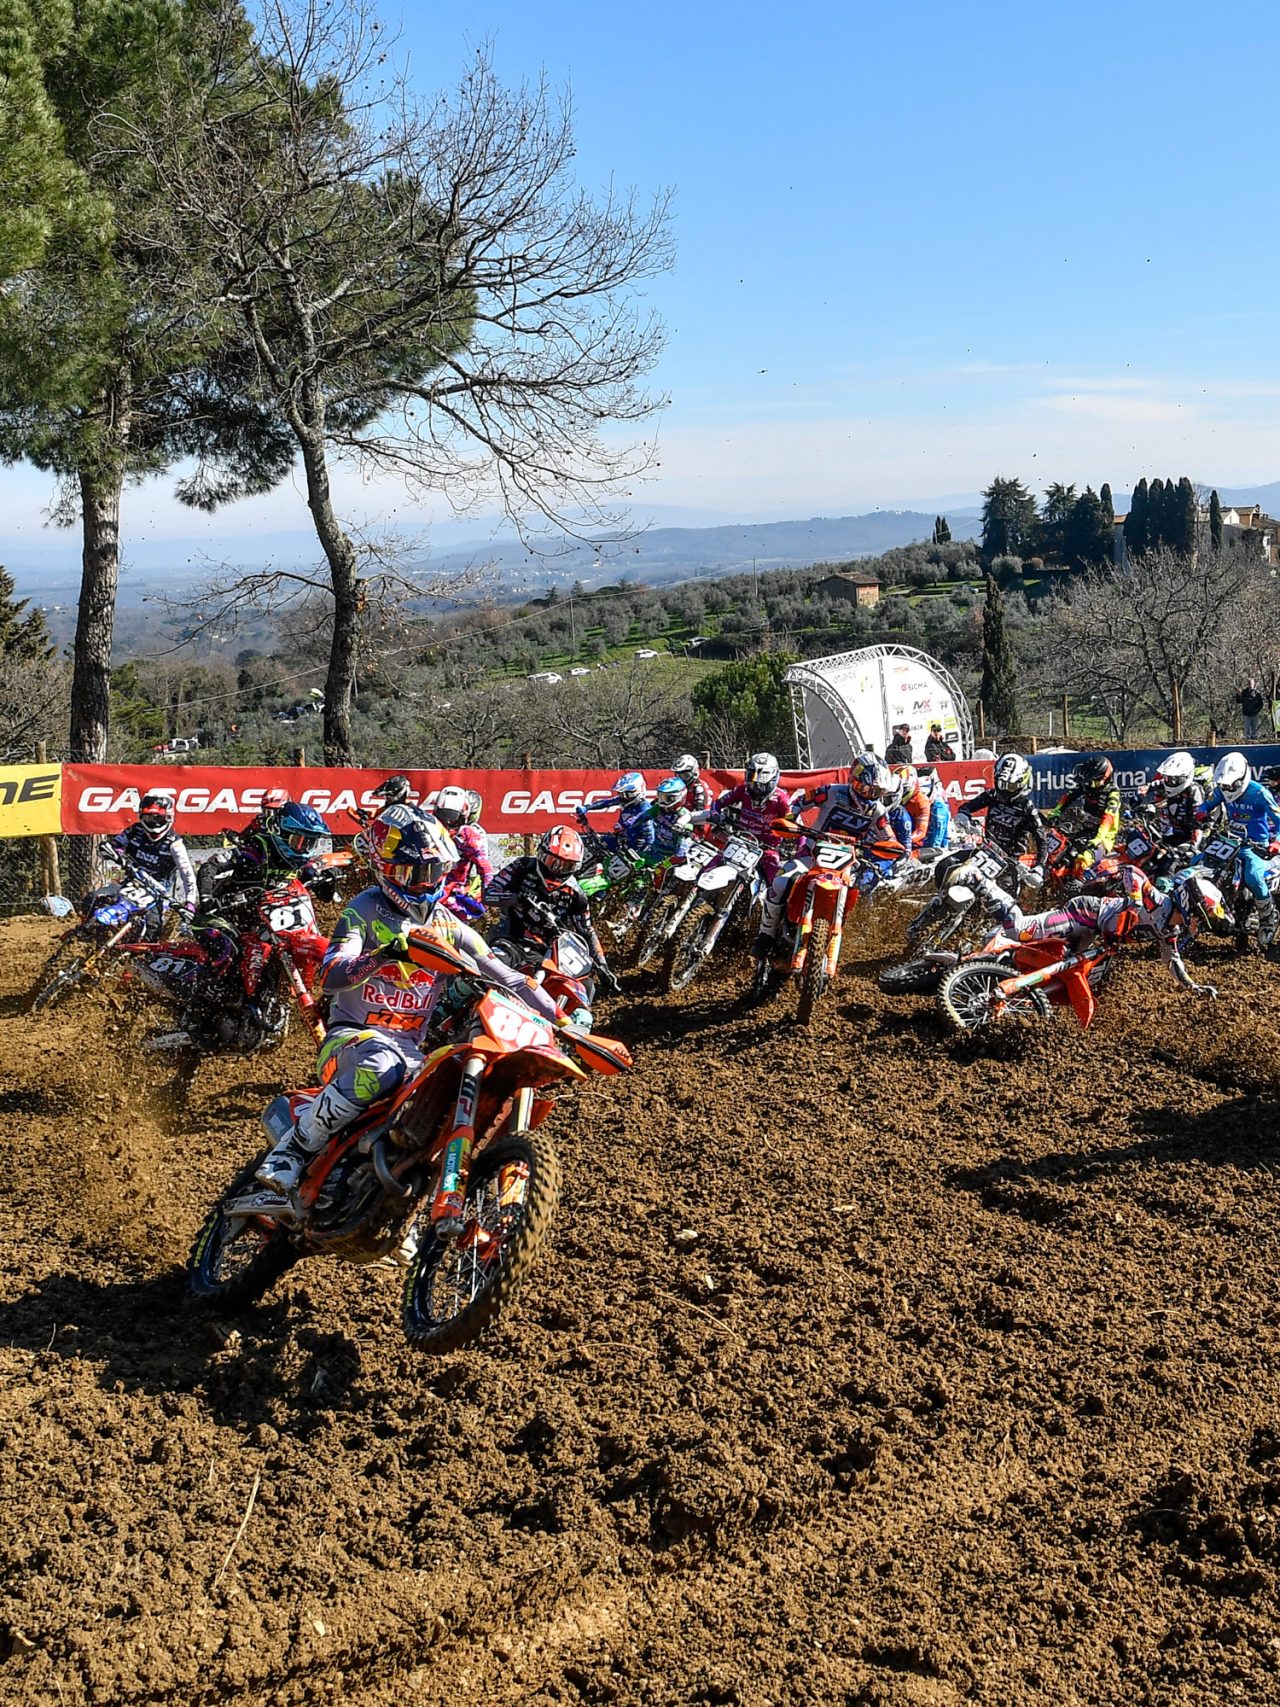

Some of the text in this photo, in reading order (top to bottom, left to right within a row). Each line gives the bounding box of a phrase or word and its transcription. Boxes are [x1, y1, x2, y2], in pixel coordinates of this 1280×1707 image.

[830, 811, 869, 831] FLY
[722, 843, 759, 869] 669
[816, 847, 853, 870] 27
[1128, 838, 1148, 855] 6
[1205, 839, 1235, 860] 20
[970, 850, 1004, 879] 515
[269, 899, 316, 932] 81
[150, 957, 187, 975] 81
[362, 982, 433, 1012] Red Bull
[364, 1008, 427, 1032] KTM
[487, 1005, 551, 1048] 80
